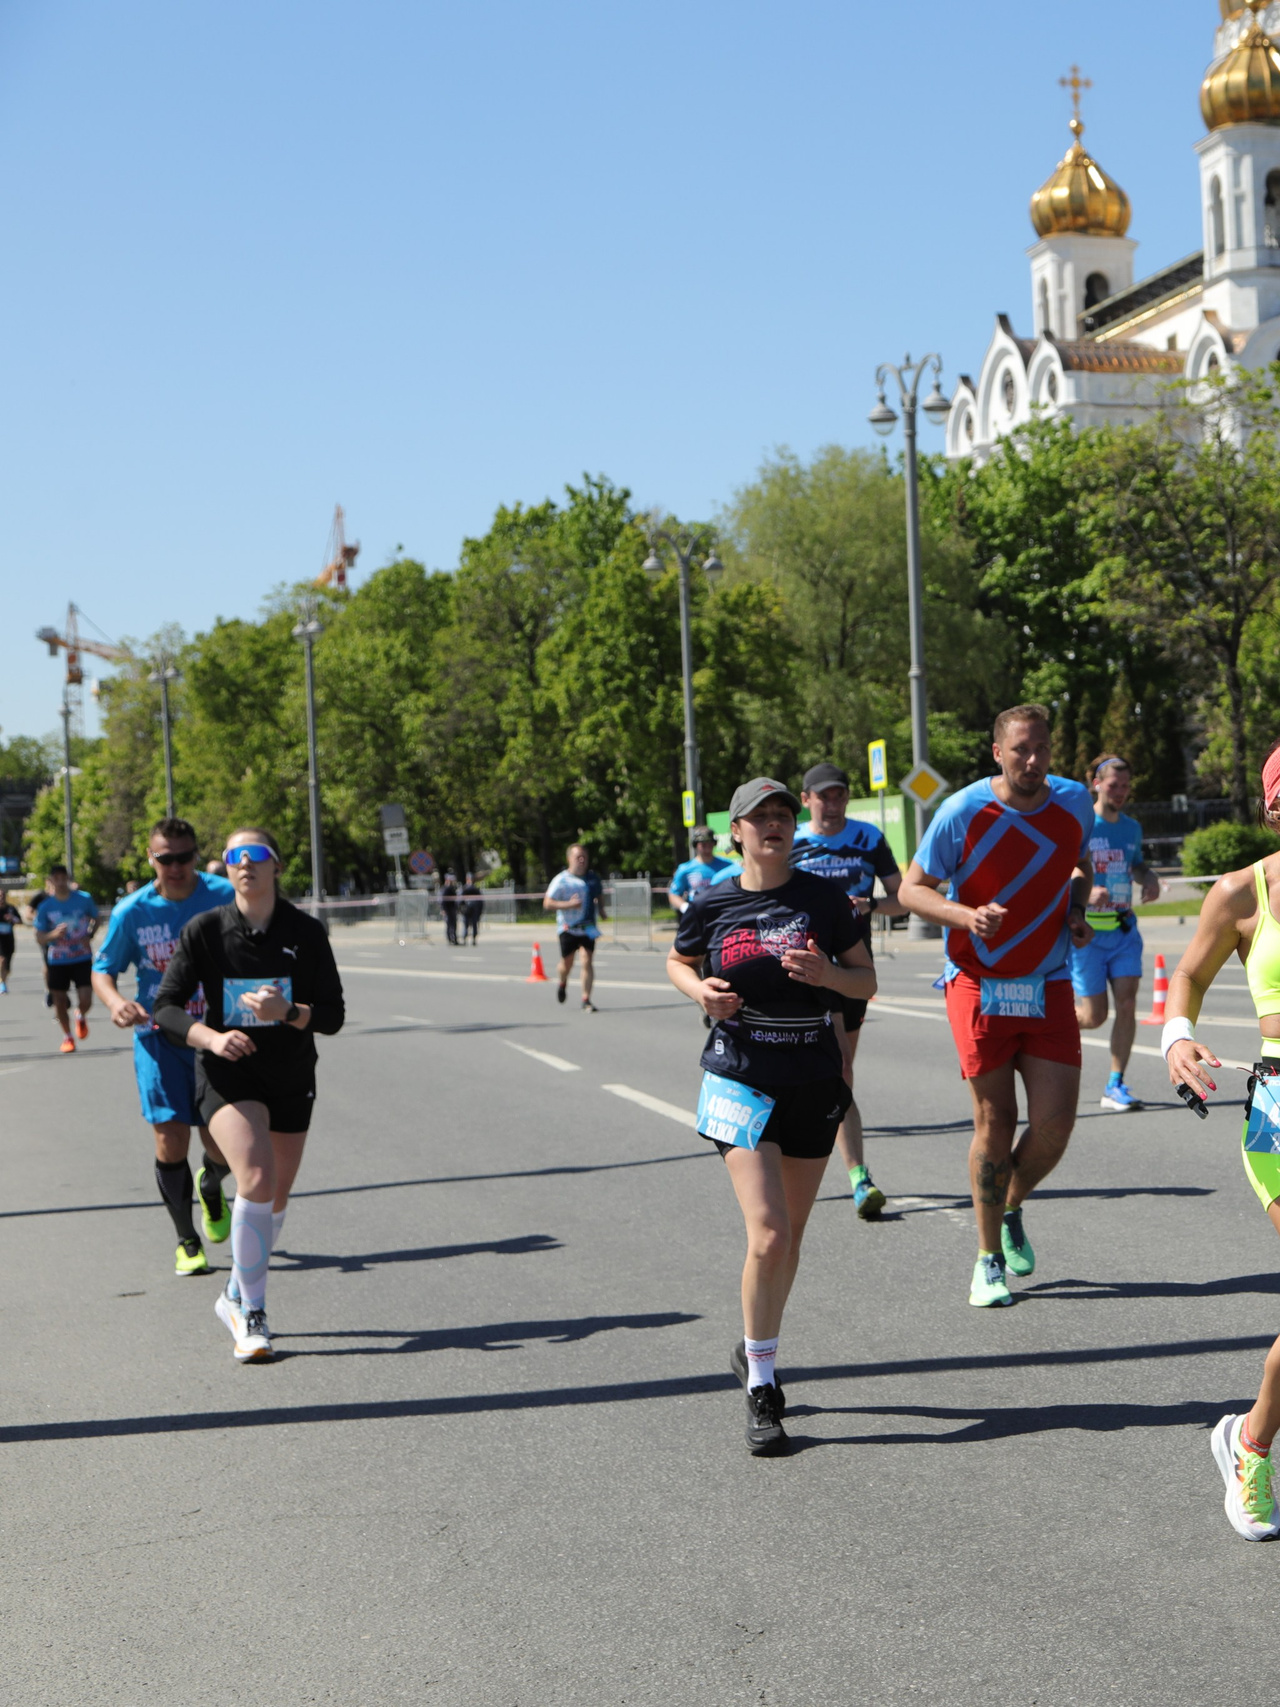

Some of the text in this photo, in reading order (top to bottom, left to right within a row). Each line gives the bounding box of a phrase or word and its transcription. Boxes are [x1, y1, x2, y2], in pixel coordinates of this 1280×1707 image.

[137, 923, 171, 946] 2024
[994, 983, 1033, 1001] 41039
[999, 1001, 1030, 1017] 21.1KM
[706, 1094, 753, 1127] 41066
